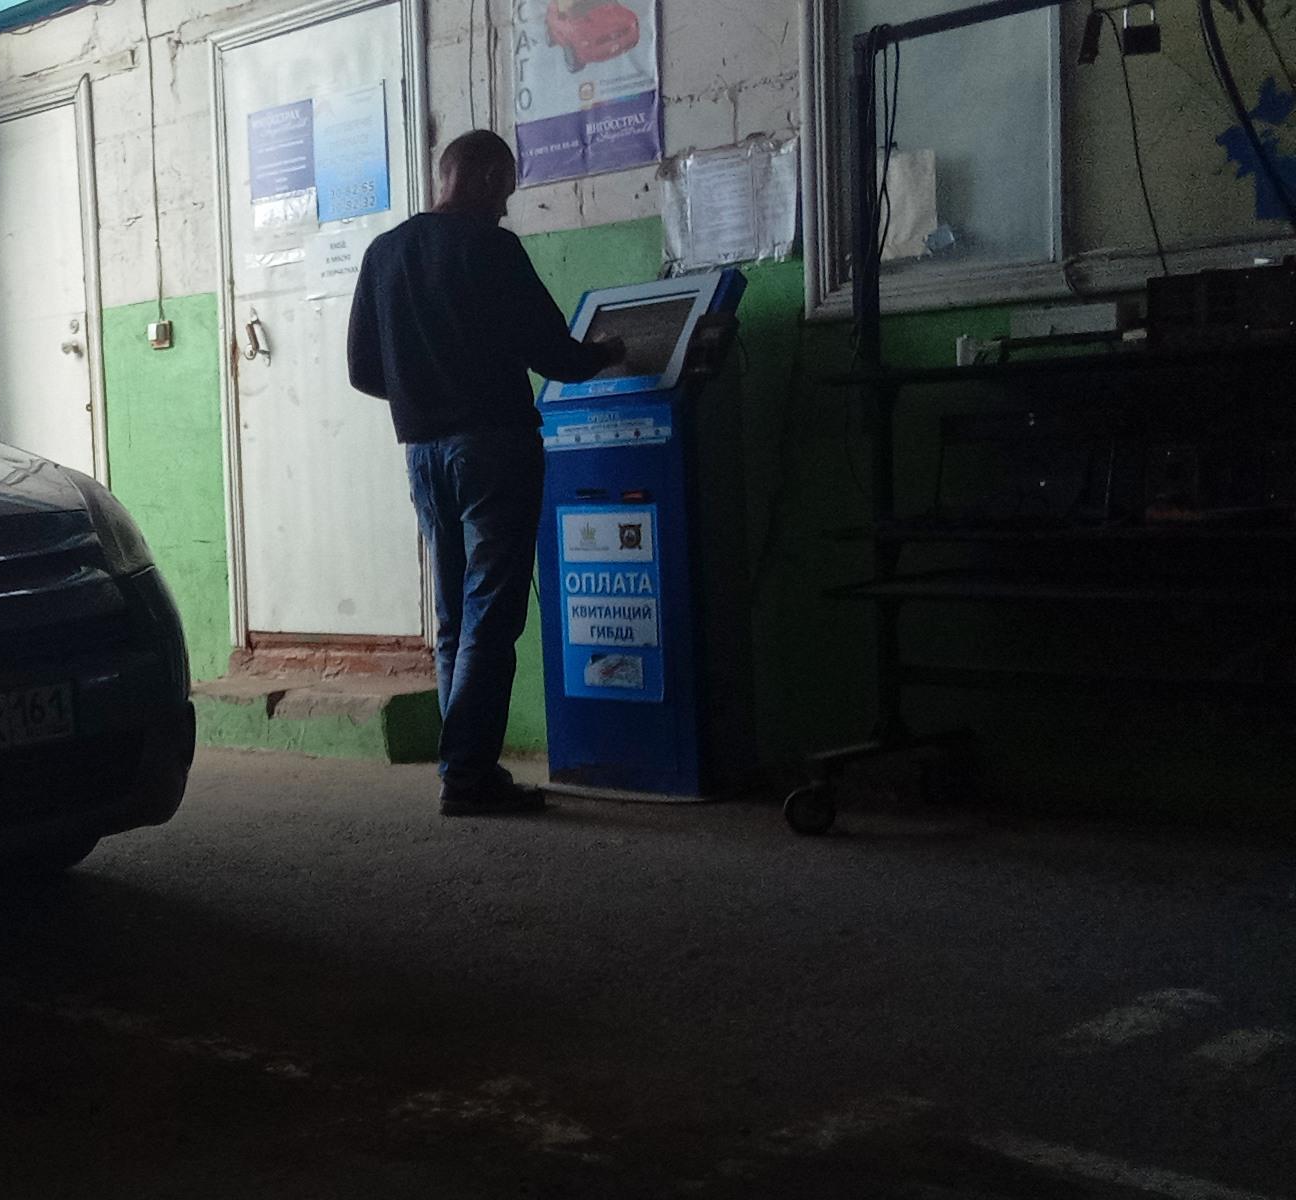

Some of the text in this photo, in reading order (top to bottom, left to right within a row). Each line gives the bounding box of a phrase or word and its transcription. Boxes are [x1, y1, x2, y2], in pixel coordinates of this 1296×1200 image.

[565, 571, 653, 595] ОПЛАТА
[572, 604, 652, 620] КВИТАНЦИЙ
[590, 625, 635, 642] ГИБДД
